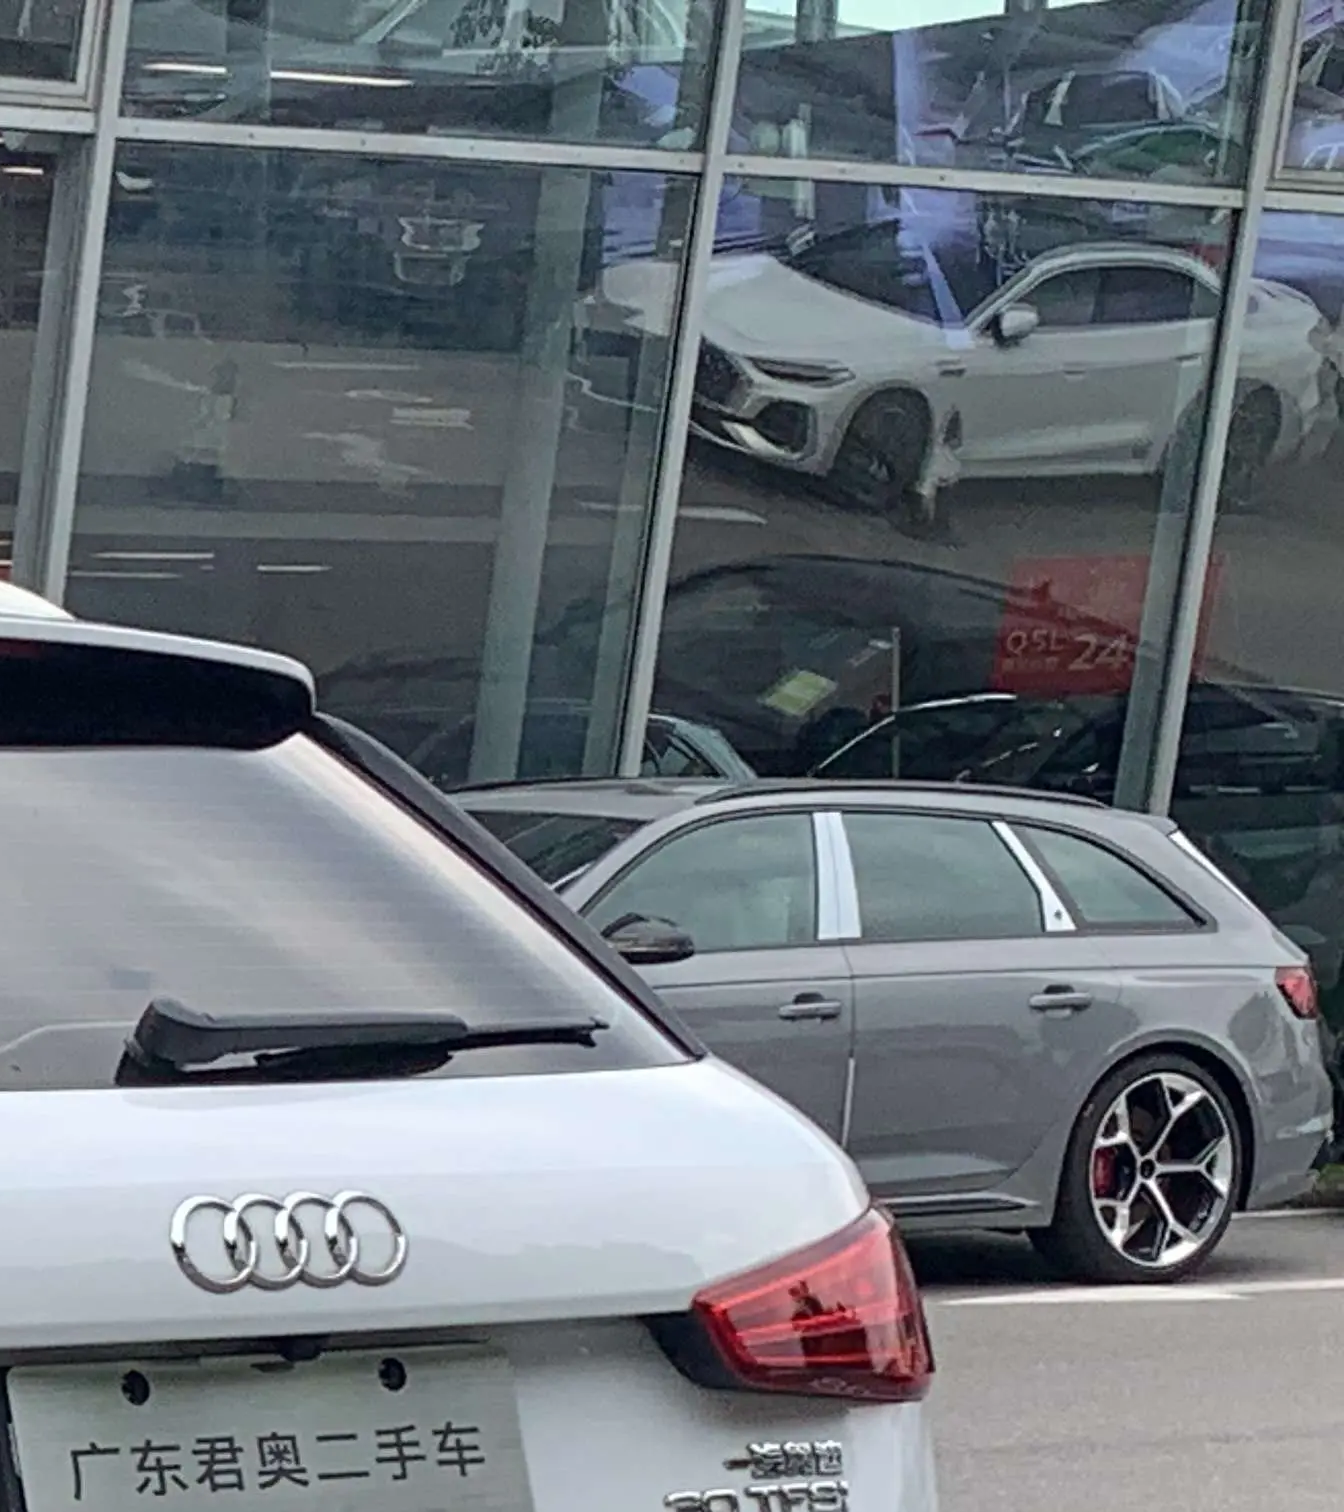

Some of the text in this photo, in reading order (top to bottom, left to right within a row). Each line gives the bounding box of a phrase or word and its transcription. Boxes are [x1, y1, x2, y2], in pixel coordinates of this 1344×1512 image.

[70, 1421, 486, 1500] 广东君奥二手车
